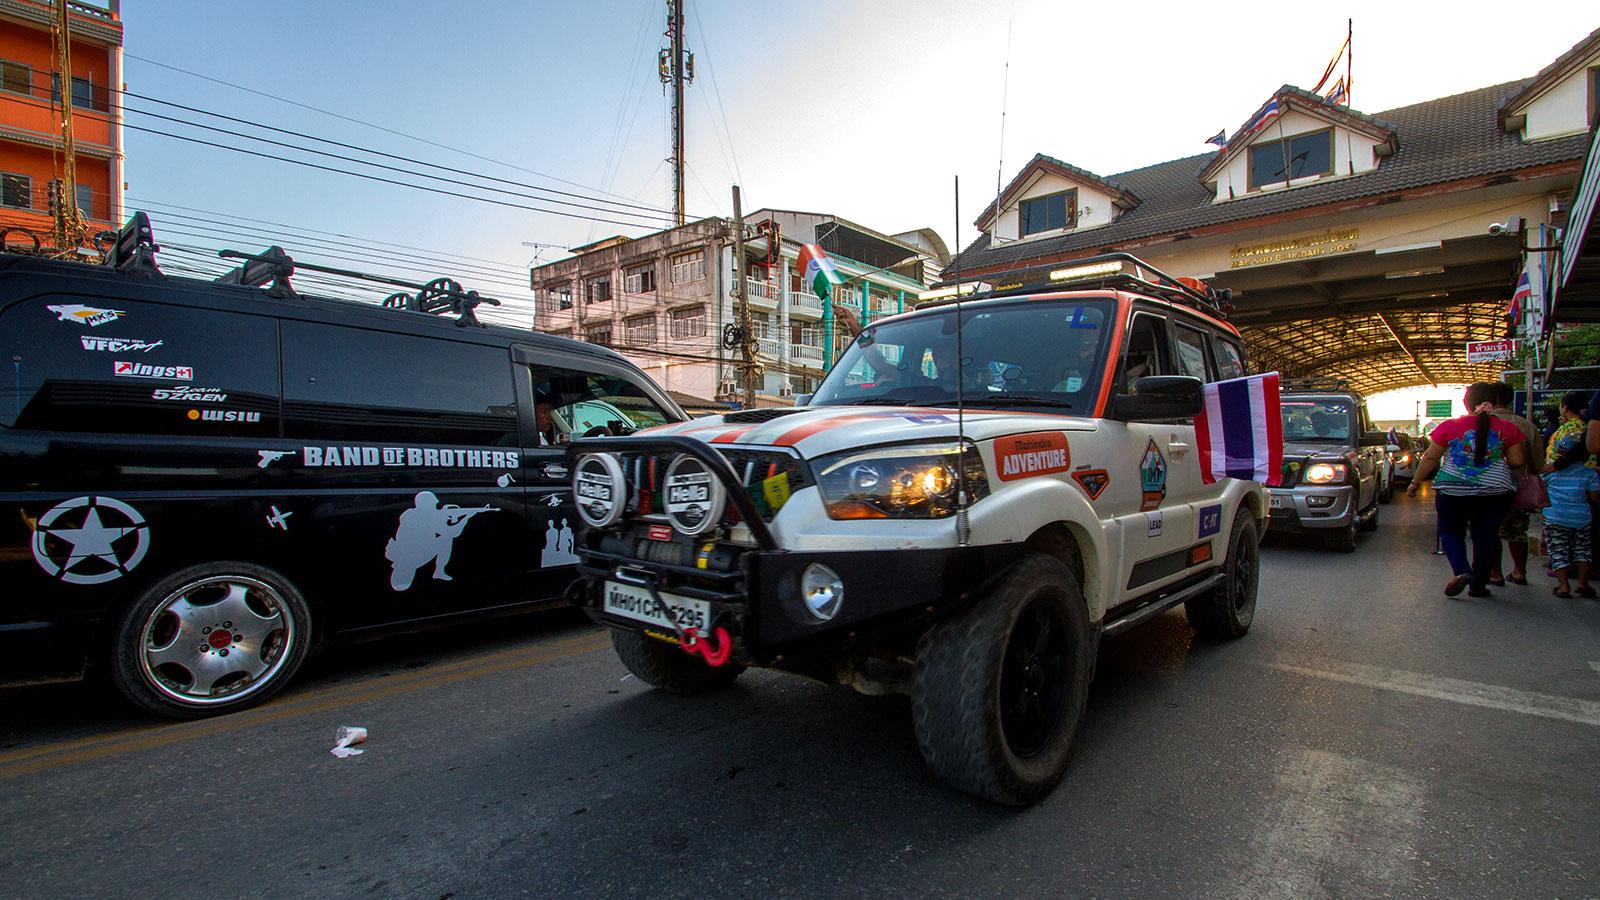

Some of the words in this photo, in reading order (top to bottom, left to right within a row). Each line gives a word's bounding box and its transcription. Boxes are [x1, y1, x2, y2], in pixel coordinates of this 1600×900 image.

[1275, 248, 1327, 261] BOUNDARY
[88, 310, 116, 324] HKS
[1014, 438, 1052, 450] Mahindra
[304, 446, 380, 467] BAND
[383, 447, 405, 466] OF
[407, 448, 519, 469] BROTHERS
[1003, 448, 1067, 476] ADVENTURE
[578, 481, 611, 500] Hella
[670, 485, 709, 502] Hella
